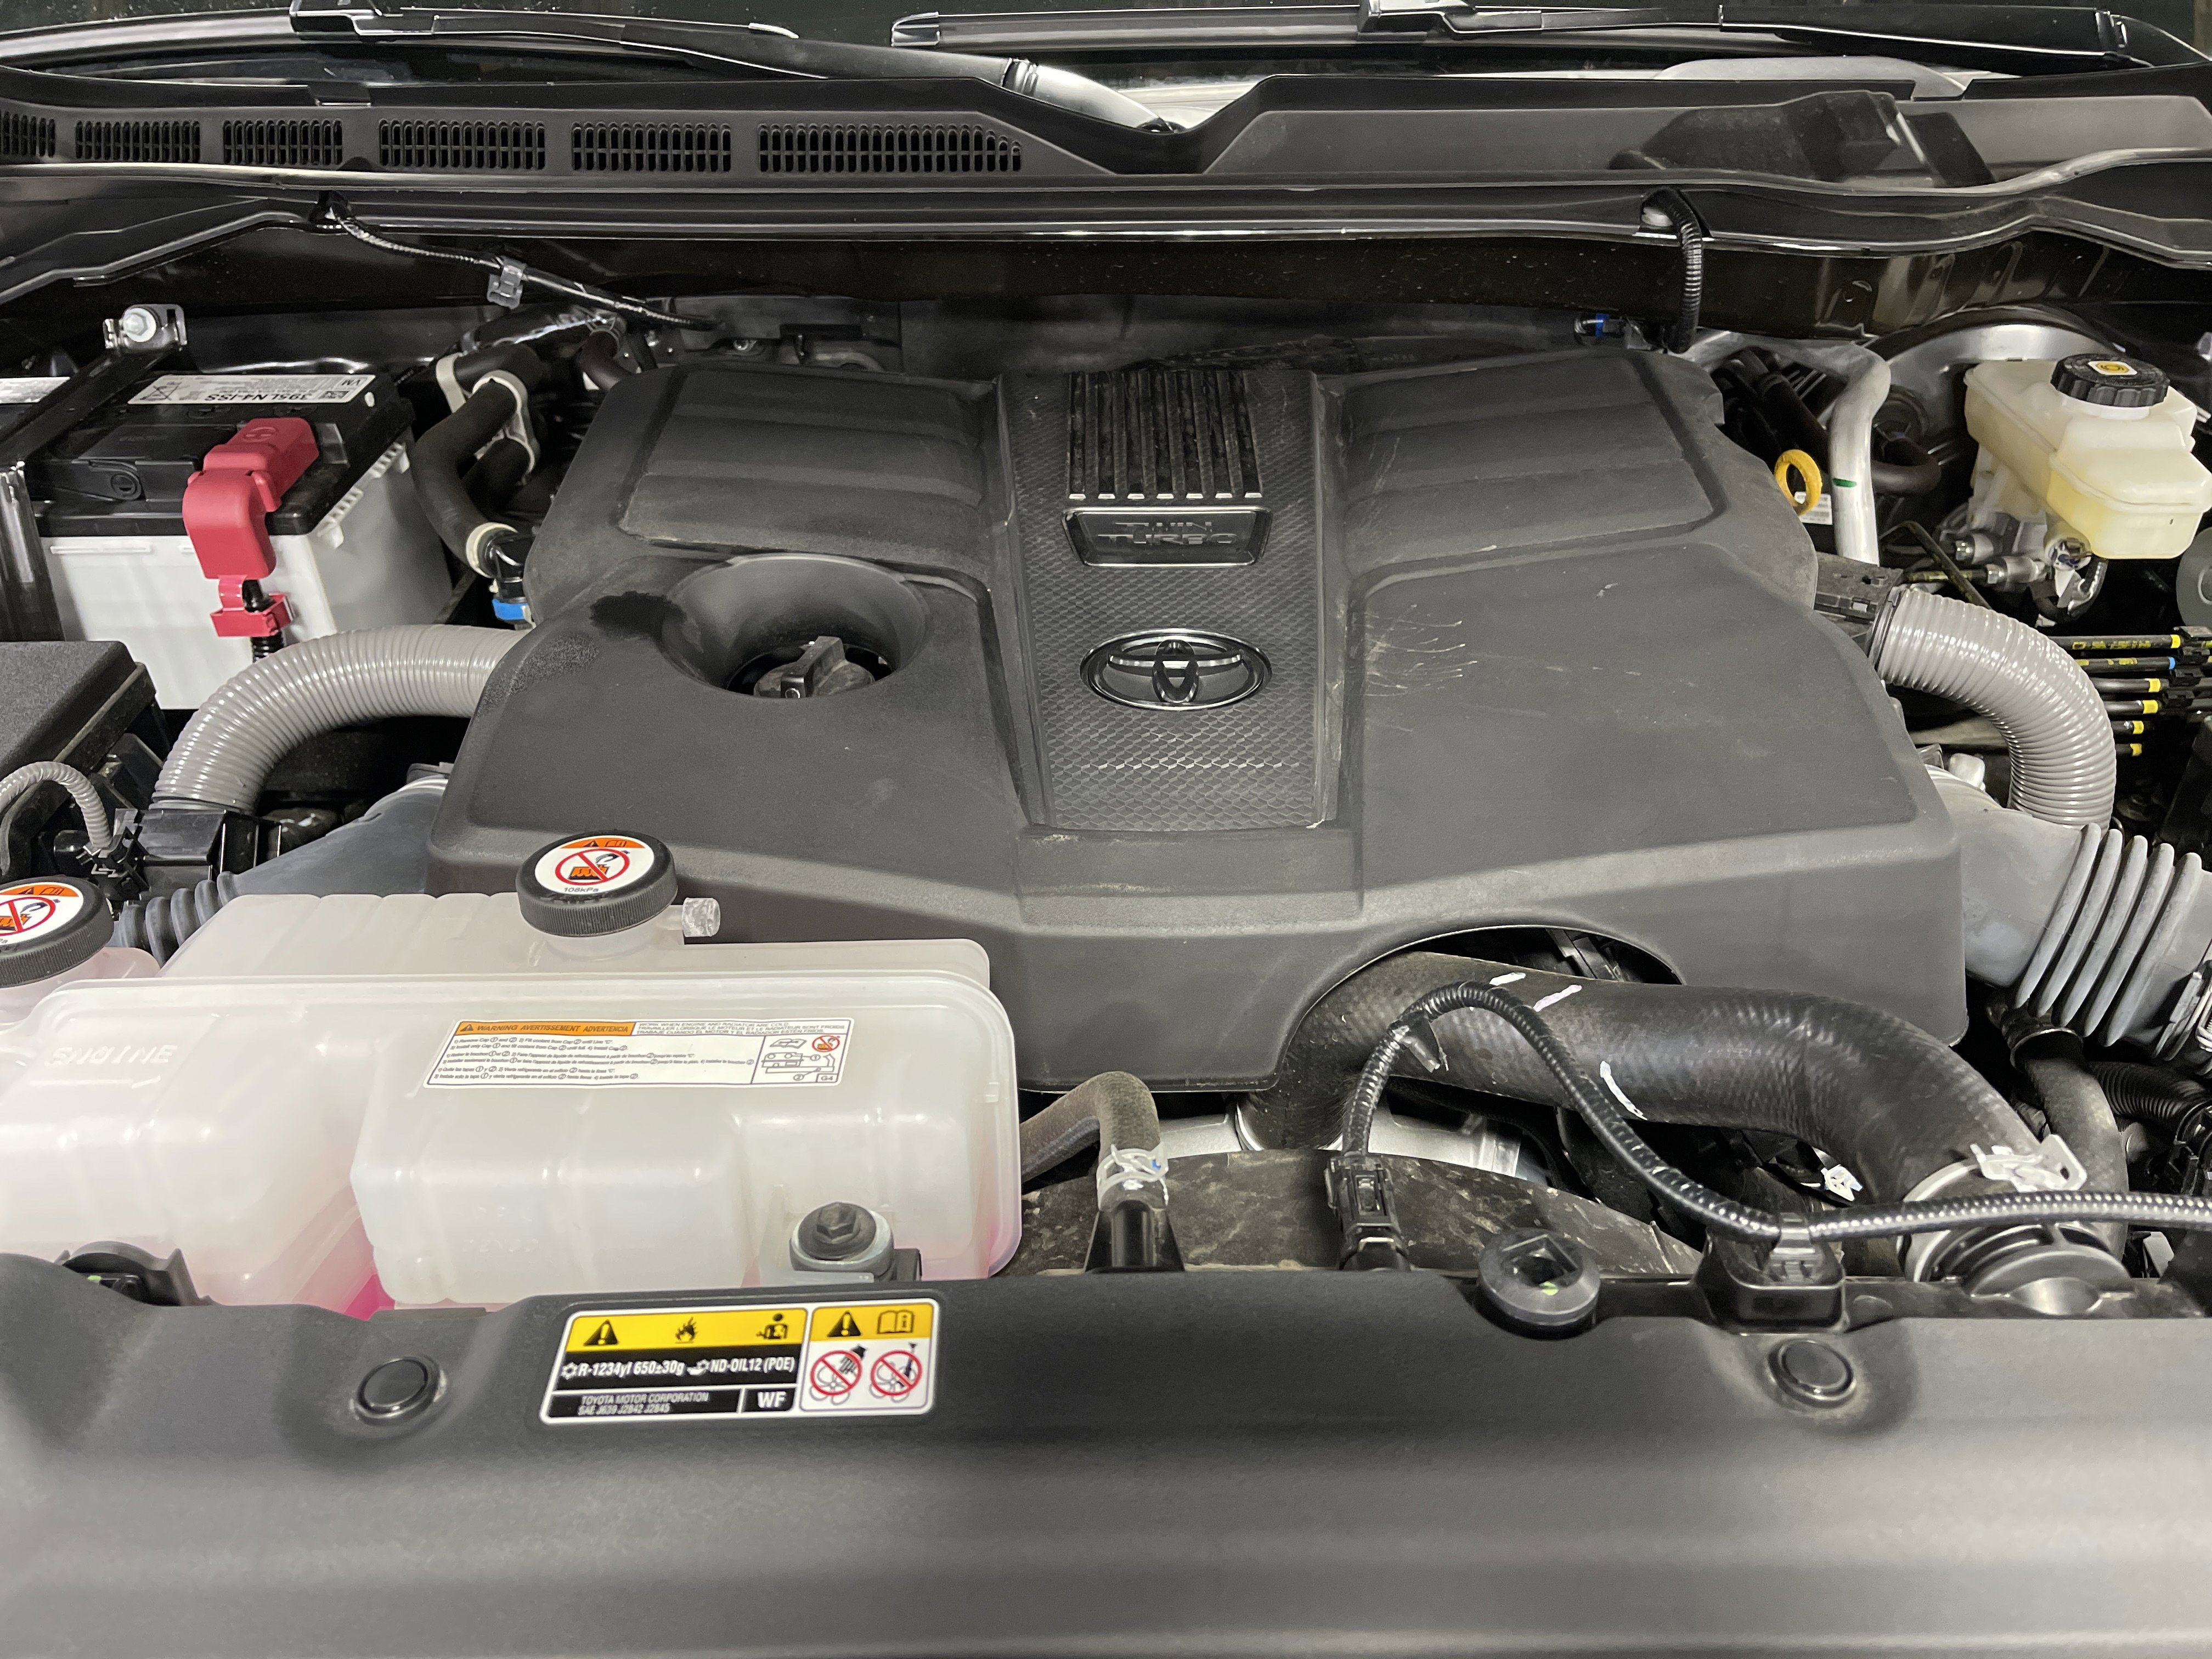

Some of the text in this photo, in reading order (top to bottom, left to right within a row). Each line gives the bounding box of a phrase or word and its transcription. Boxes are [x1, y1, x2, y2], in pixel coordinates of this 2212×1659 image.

[1097, 533, 1238, 545] TURBO
[633, 1360, 685, 1376] 650±30g
[710, 1357, 761, 1373] ND-OIL12
[763, 1357, 795, 1373] (POE)
[581, 1392, 709, 1405] TOYOTA MOTOR CORPORATION
[757, 1390, 787, 1409] WF
[578, 1404, 596, 1415] SAE
